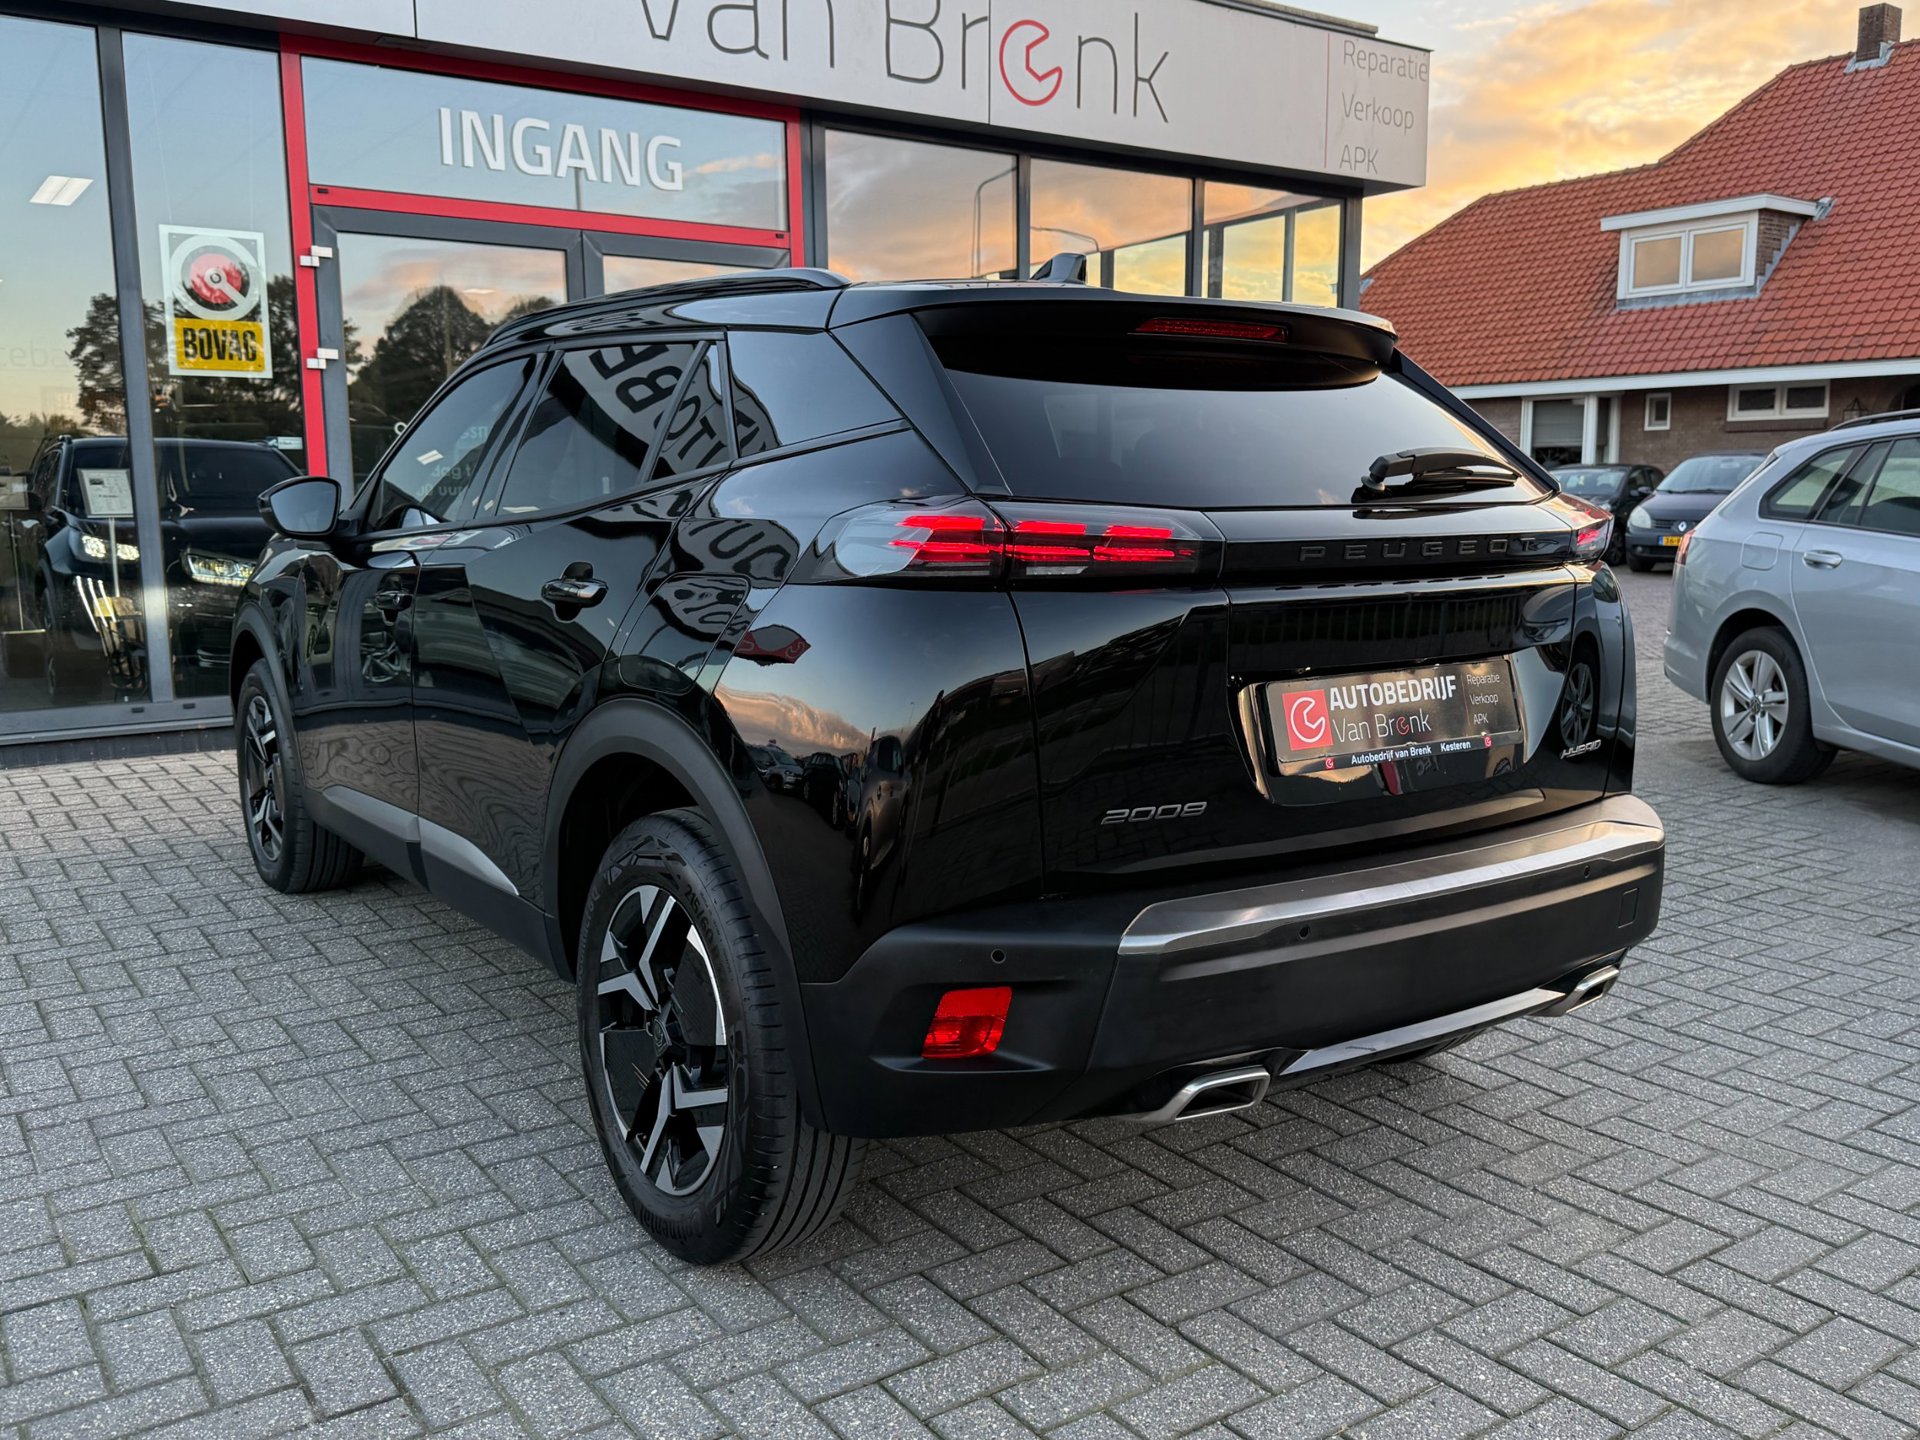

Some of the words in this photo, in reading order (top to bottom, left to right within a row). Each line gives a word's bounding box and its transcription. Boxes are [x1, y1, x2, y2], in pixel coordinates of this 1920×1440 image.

[1343, 39, 1428, 82] Reparatie
[1342, 91, 1415, 135] Verkoop
[439, 106, 684, 190] INGANG
[1339, 144, 1379, 174] APK
[182, 327, 258, 362] BOVAG
[1300, 537, 1536, 561] PEUGEOT
[1330, 675, 1457, 711] AUTOBEDRIJF
[1466, 673, 1501, 688] Reparatie
[1469, 693, 1499, 705] Verkoop
[1333, 717, 1372, 743] Van
[1473, 713, 1489, 726] APK
[1351, 750, 1394, 765] Autobedrijf
[1394, 750, 1410, 759] van
[1410, 745, 1432, 757] Brenk
[1440, 741, 1472, 752] Kesteren
[1101, 801, 1208, 825] 2008
